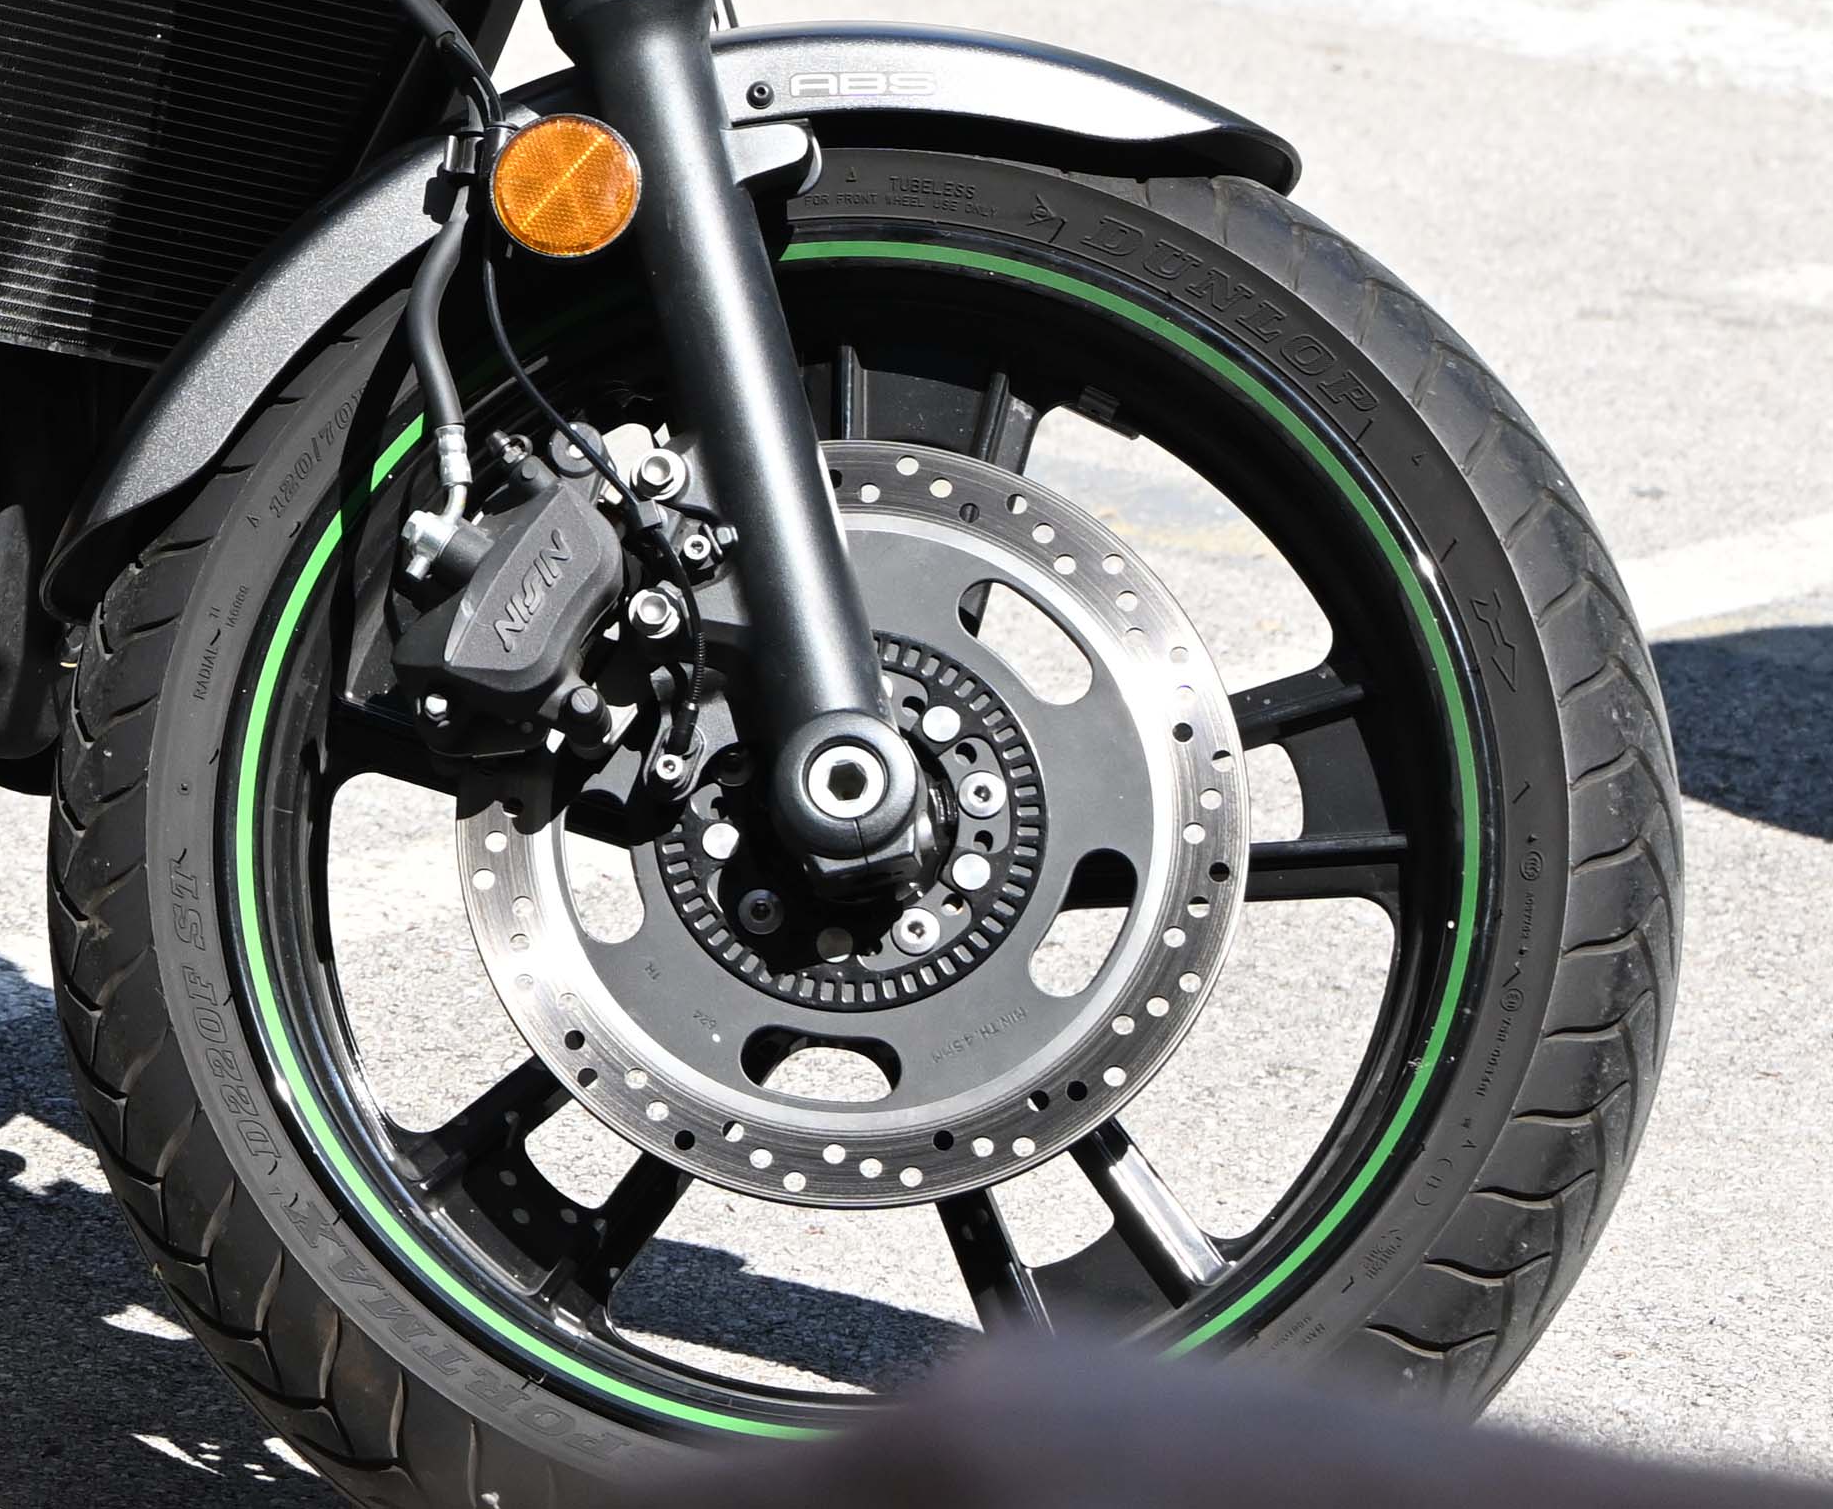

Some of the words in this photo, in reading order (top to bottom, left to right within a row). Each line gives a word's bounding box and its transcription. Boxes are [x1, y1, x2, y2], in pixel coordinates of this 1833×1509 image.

[789, 72, 937, 98] ABS
[889, 176, 976, 200] TUBELESS
[804, 193, 830, 207] FOR
[836, 193, 878, 206] FRONT
[886, 194, 925, 209] WHEEL
[933, 198, 958, 212] USE
[964, 202, 998, 219] ONLY
[1079, 214, 1381, 413] DUNLOP
[192, 646, 219, 701] RADIAL
